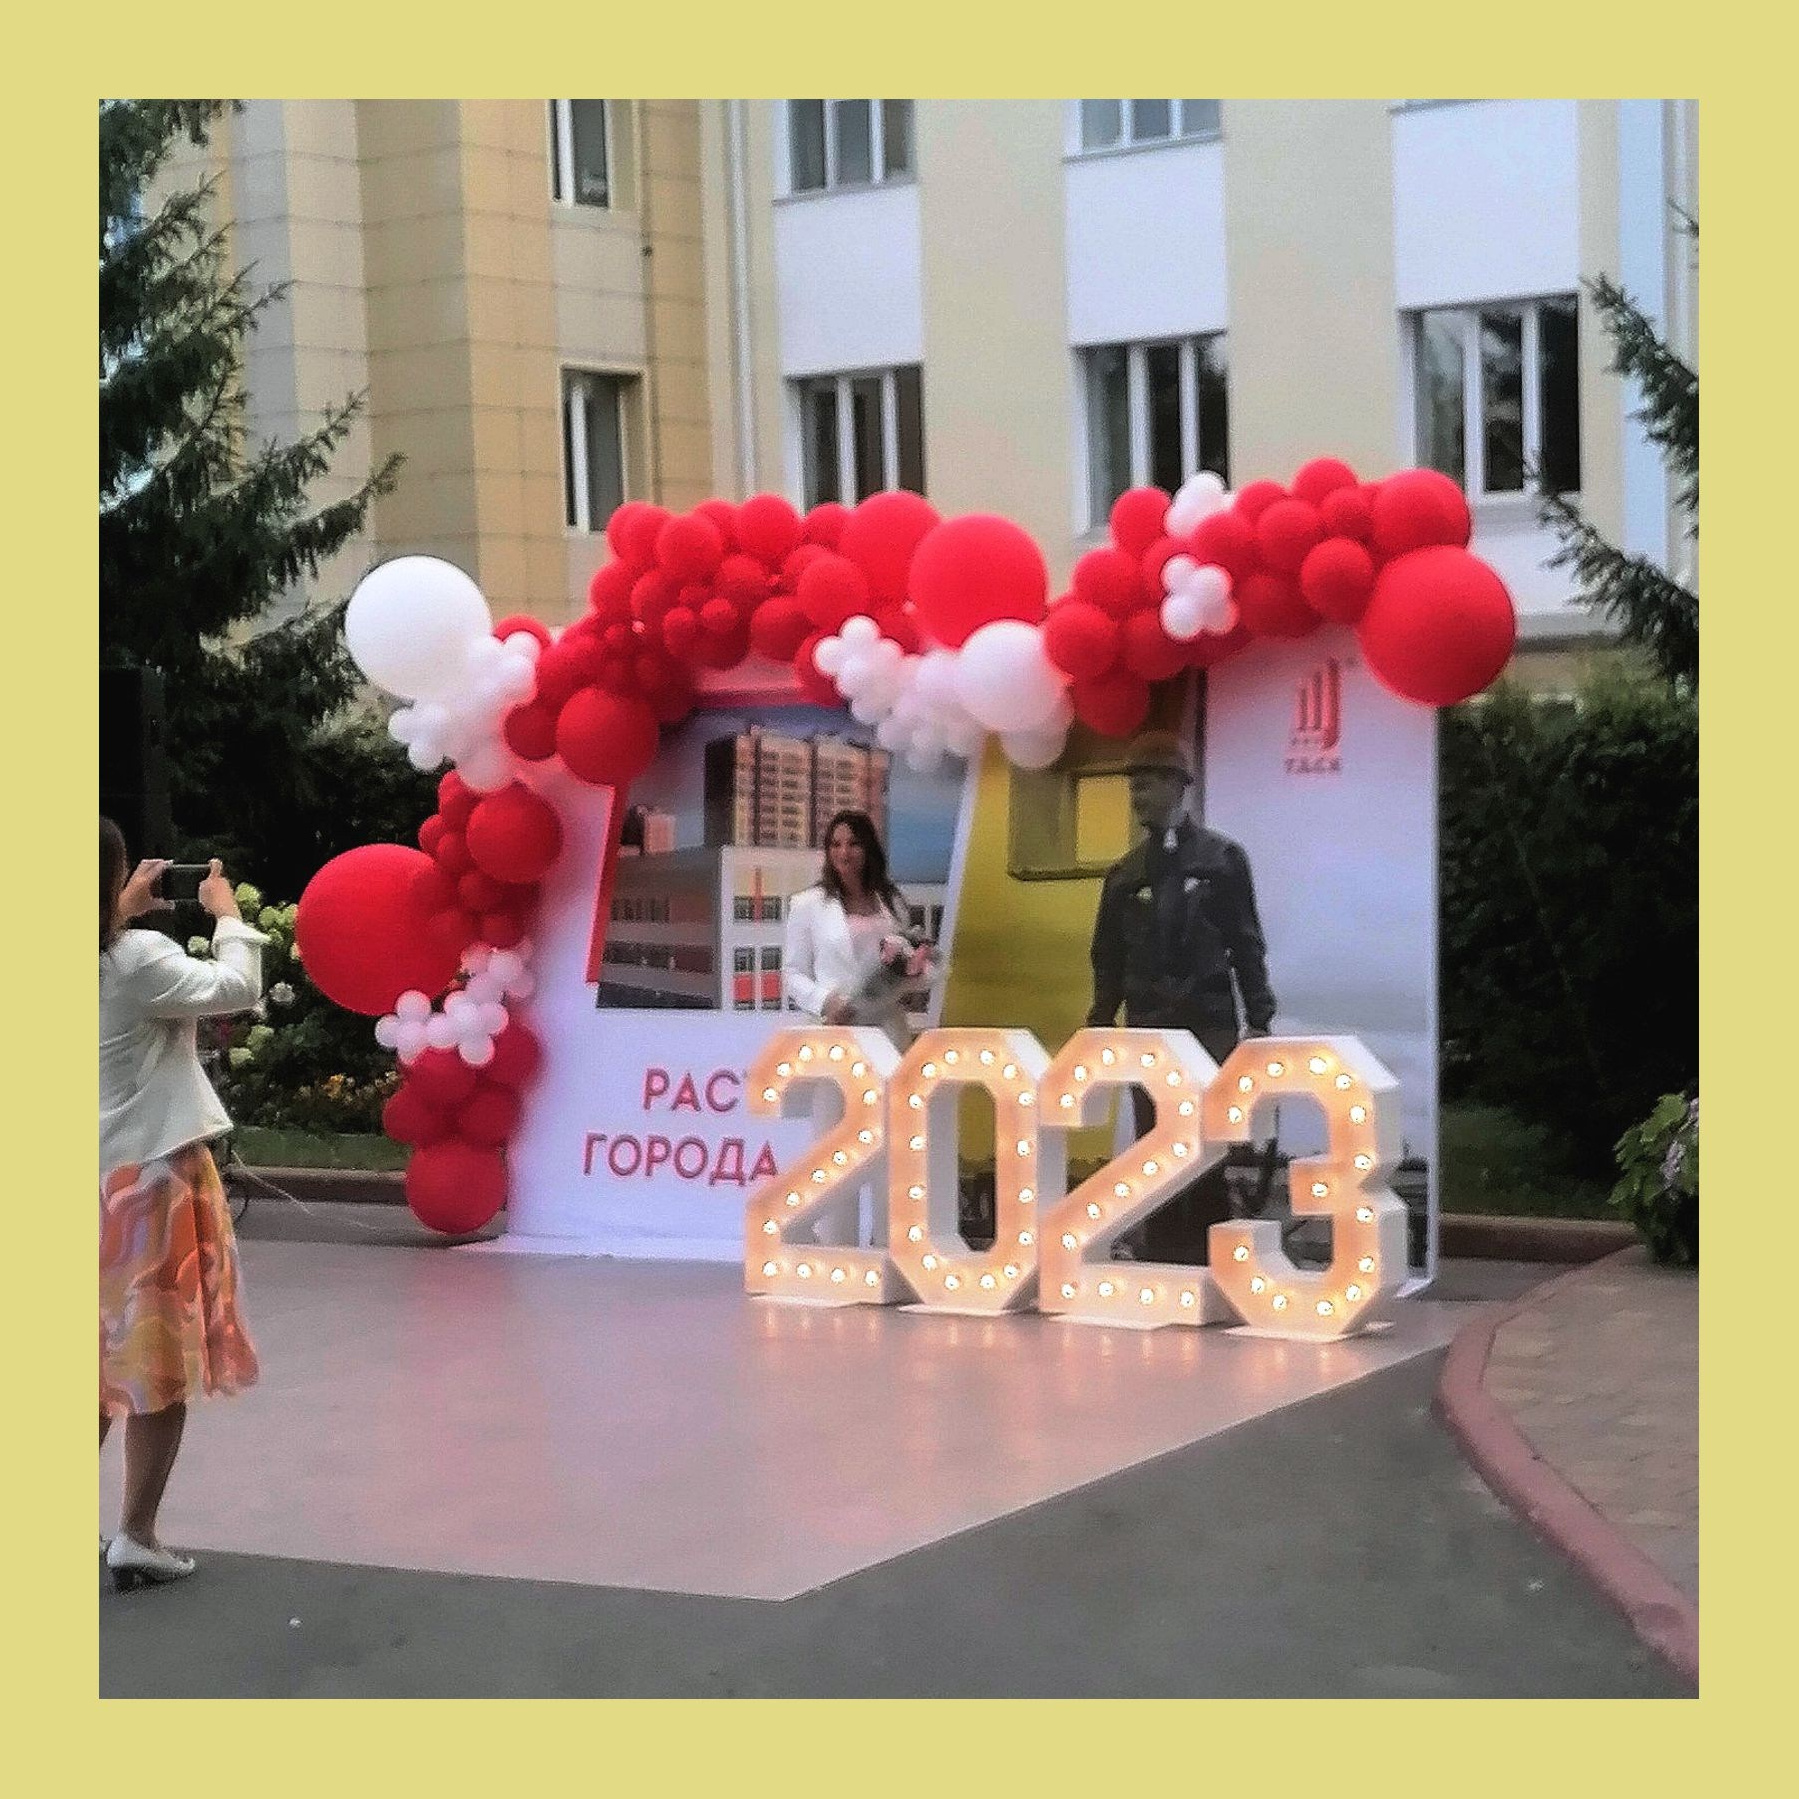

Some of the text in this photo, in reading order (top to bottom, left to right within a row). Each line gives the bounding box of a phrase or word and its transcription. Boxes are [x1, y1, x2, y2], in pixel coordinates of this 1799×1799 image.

[643, 1067, 749, 1112] РАС
[583, 1132, 779, 1185] ГОРОДА
[745, 1026, 1404, 1337] 2023
